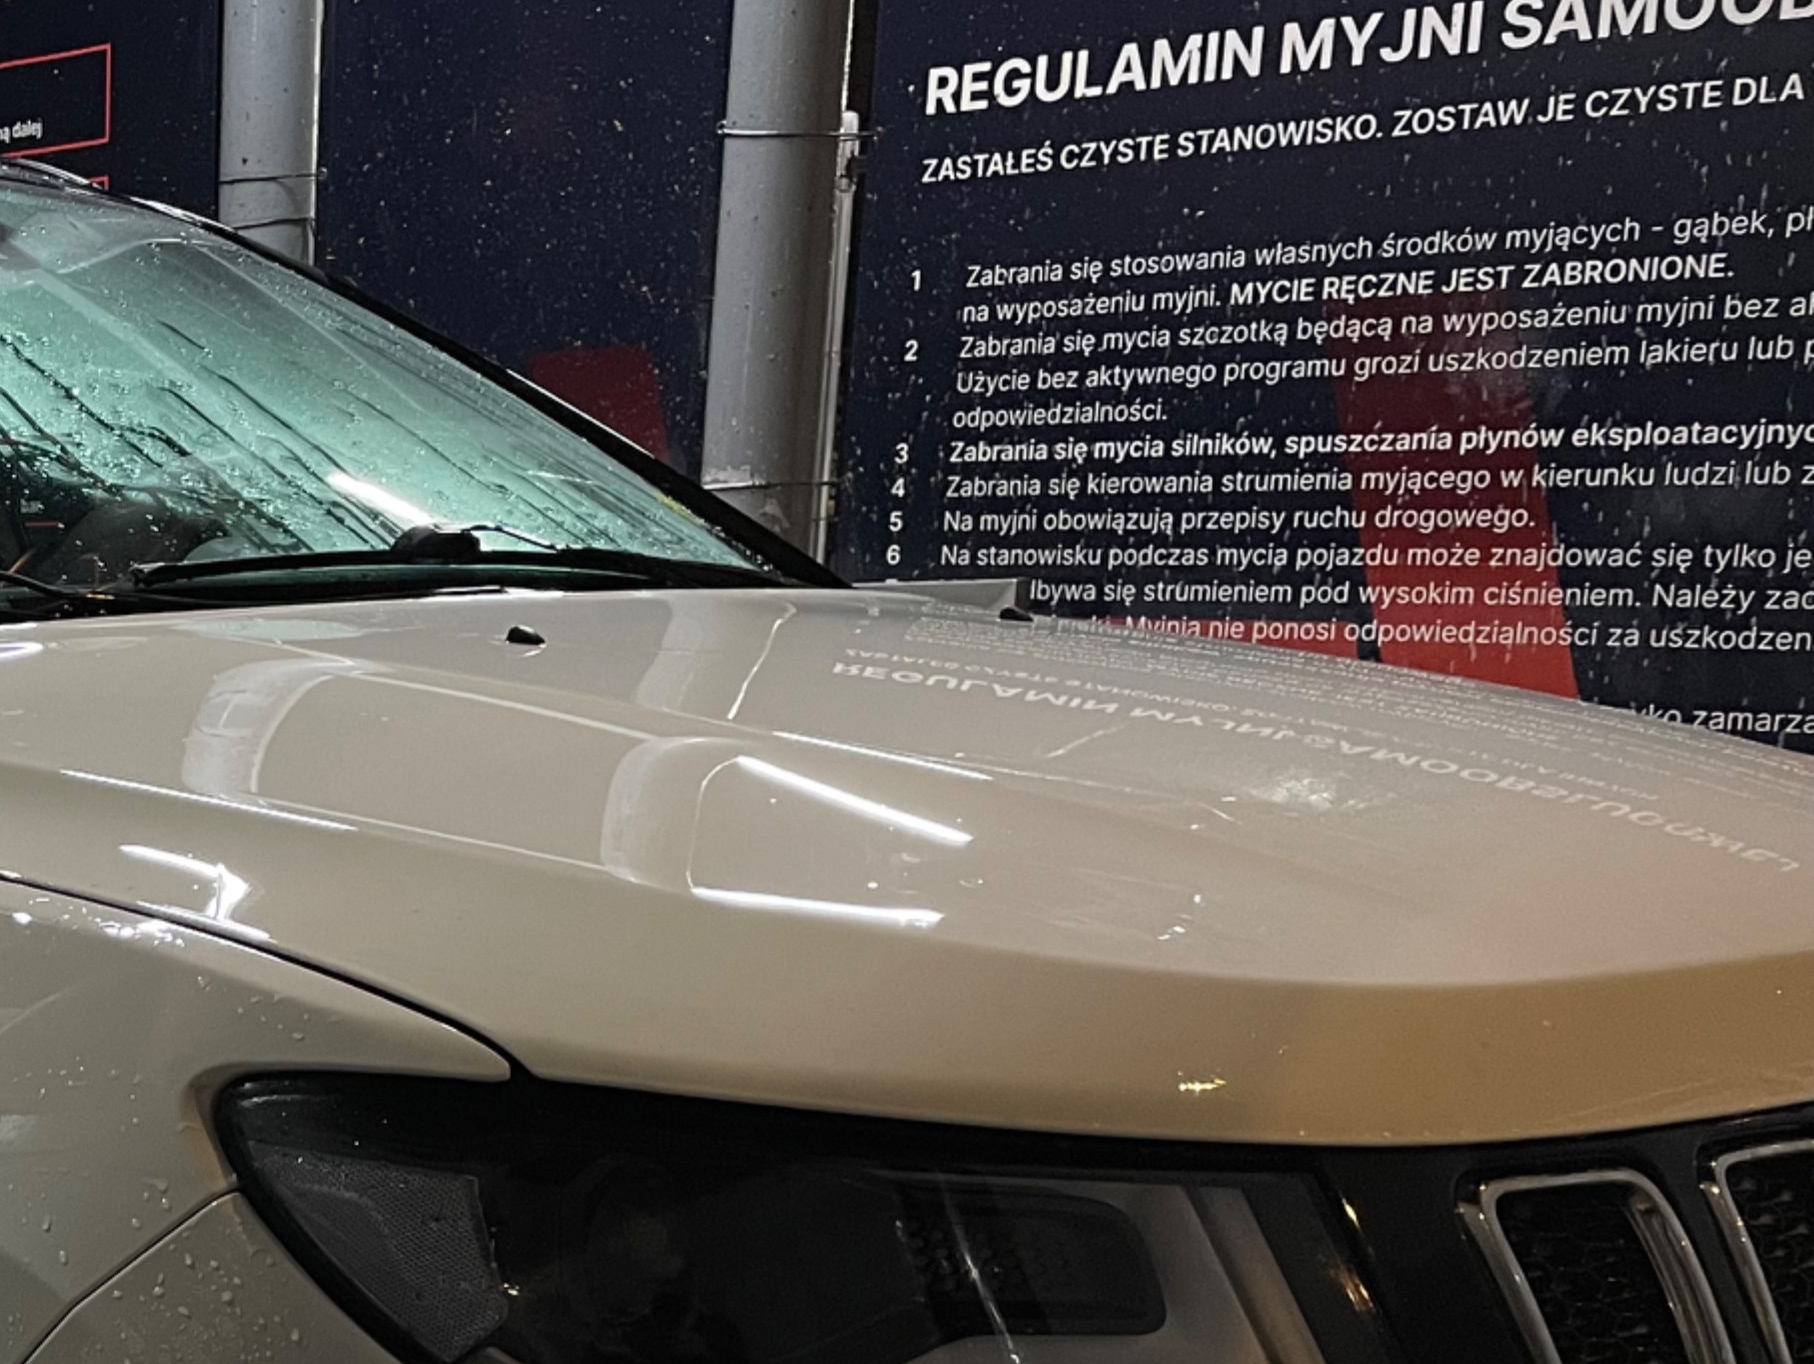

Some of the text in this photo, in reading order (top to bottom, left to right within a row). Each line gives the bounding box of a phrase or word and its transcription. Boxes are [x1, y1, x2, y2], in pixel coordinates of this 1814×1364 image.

[925, 25, 1265, 116] REGULAMIN
[1279, 0, 1485, 75] MYJNI
[12, 119, 43, 139] dalej
[921, 73, 1805, 184] ZASTAŁEŚ CZYSTE STANOWISKO. ZOSTAW JE CZYSTE DLA
[911, 269, 922, 292] 1
[965, 259, 1063, 288] Zabrania
[1069, 256, 1103, 284] się
[1109, 245, 1246, 278] stosowania
[1254, 236, 1373, 268] własnych
[1381, 226, 1498, 258] środków
[1505, 216, 1641, 254] myjących
[1672, 209, 1775, 245] gąbek,
[961, 253, 1735, 326] na wyposażeniu myjni. MYCIE RĘCZNE JEST ZABRONIONE.
[903, 339, 919, 362] 2
[959, 332, 1056, 358] Zabrania
[1062, 329, 1096, 357] się
[1100, 324, 1171, 354] mycia
[1177, 319, 1288, 347] szczotką
[1295, 315, 1394, 345] będącą
[1401, 314, 1434, 335] na
[1442, 299, 1627, 337] wyposażeniu
[1635, 295, 1715, 328] myjni
[1723, 294, 1780, 319] bez
[956, 368, 1030, 397] Użycie
[1037, 367, 1079, 390] bez
[1085, 364, 1217, 394] aktywnego
[1223, 355, 1347, 387] programu
[1353, 349, 1421, 381] grozi
[1427, 341, 1630, 372] uszkodzeniem
[1639, 337, 1738, 364] lakieru
[1747, 335, 1794, 360] lub
[952, 398, 1168, 432] odpowiedzialności.
[894, 442, 909, 464] 3
[949, 438, 1048, 463] Zabrania
[1053, 436, 1088, 464] się
[1093, 434, 1165, 463] mycia
[1170, 431, 1277, 459] silników,
[1284, 426, 1453, 459] spuszczania
[1459, 423, 1565, 455] płynów
[890, 477, 906, 498] 4
[946, 474, 1042, 498] Zabrania
[1047, 473, 1081, 500] się
[1087, 470, 1214, 495] kierowania
[1220, 467, 1353, 492] strumienia
[1360, 466, 1491, 495] myjącego
[1499, 468, 1525, 487] w
[1531, 462, 1655, 487] kierunku
[1664, 460, 1736, 486] ludzi
[1744, 460, 1791, 485] lub
[889, 504, 1535, 536] 5 Na myjni obowiązują przepisy ruchu drogowego.
[886, 541, 1813, 574] 6 Na stanowisku podczas mycia pojazdu może znajdować się tylko je
[1103, 579, 1136, 606] się
[1143, 579, 1293, 602] strumieniem
[1299, 581, 1350, 609] pod
[1359, 580, 1475, 609] wysokim
[1483, 580, 1641, 607] ciśnieniem.
[1651, 583, 1756, 614] Należy
[1207, 616, 1245, 640] nie
[1251, 617, 1337, 643] ponosi
[1344, 618, 1598, 647] odpowiedzialności
[1606, 627, 1639, 647] za
[1649, 624, 1812, 650] uszkodzen
